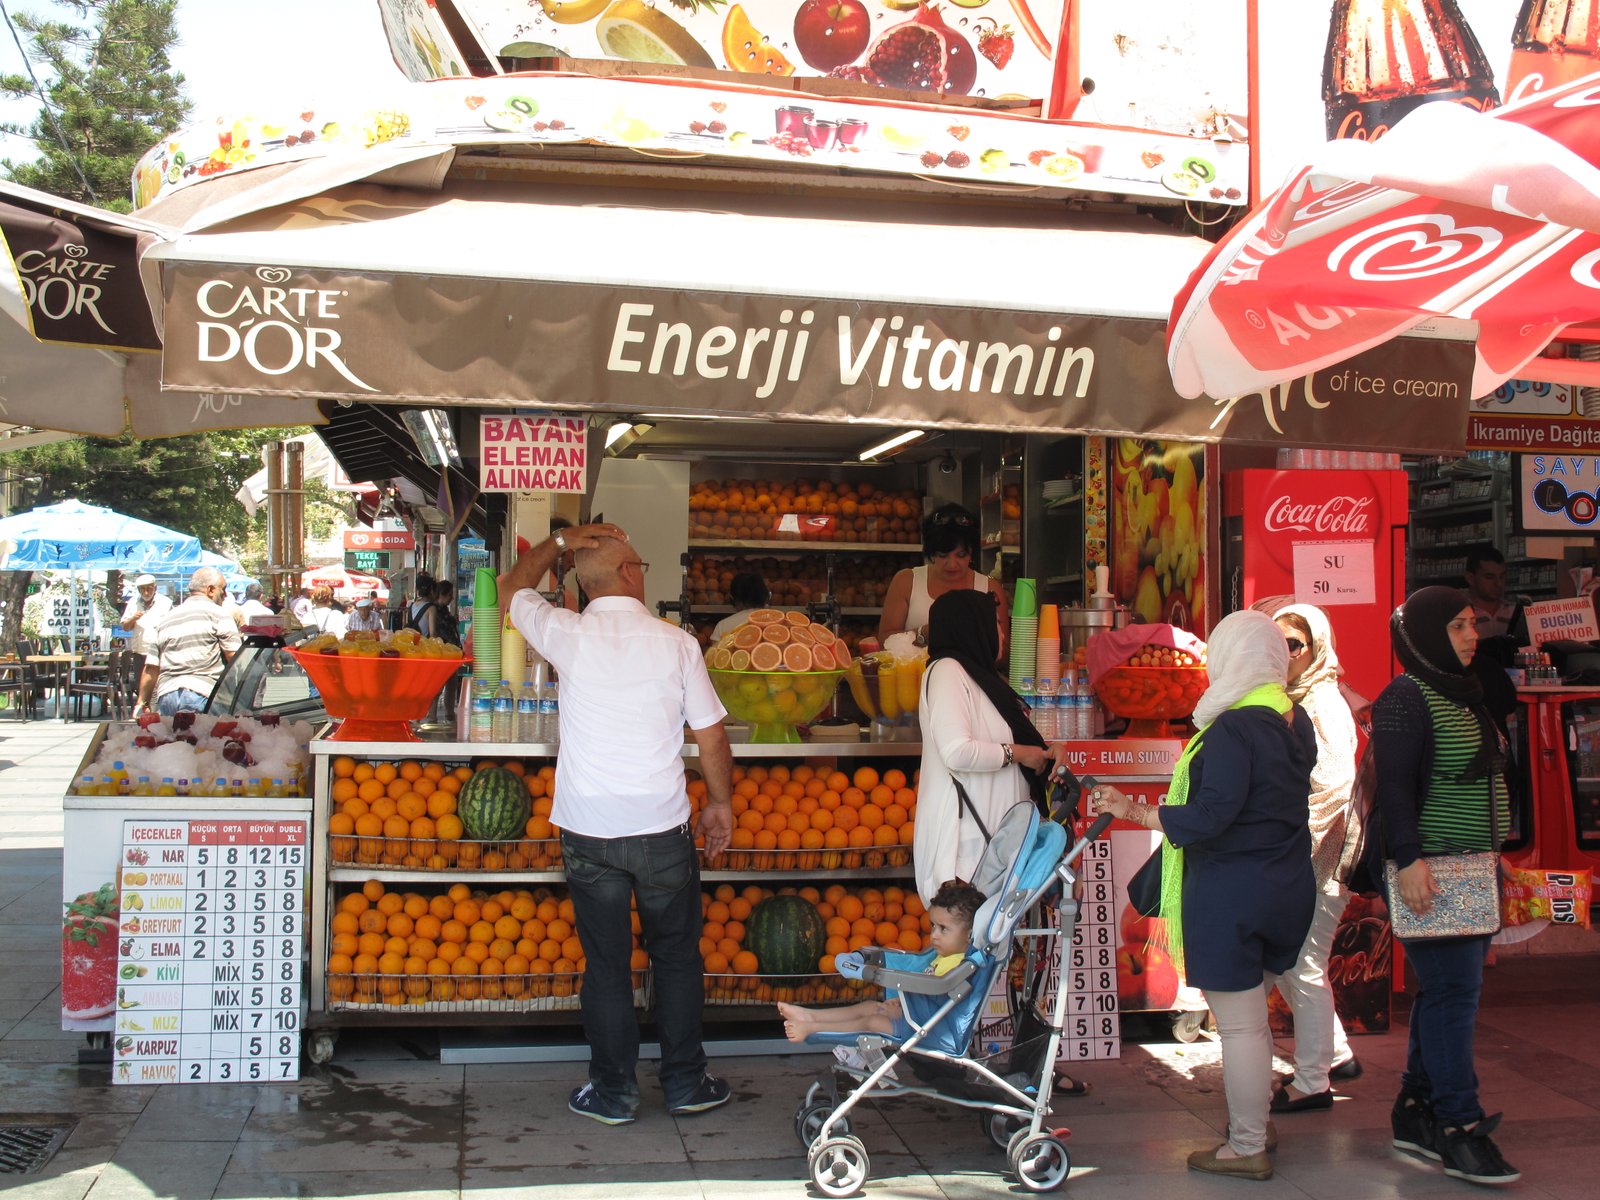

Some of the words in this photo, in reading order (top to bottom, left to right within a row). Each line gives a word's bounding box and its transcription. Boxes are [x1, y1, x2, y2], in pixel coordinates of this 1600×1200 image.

[15, 250, 116, 281] CARTE
[197, 279, 342, 324] CARTE
[606, 302, 816, 399] Enerji
[837, 315, 1096, 398] Vitamin
[1329, 371, 1350, 392] of
[1353, 371, 1386, 394] ice
[1392, 377, 1459, 399] cream
[484, 417, 584, 443] BAYAN
[1473, 419, 1545, 446] İkramiye
[484, 446, 585, 468] ELEMAN
[484, 468, 582, 490] ALINACAK
[1264, 495, 1375, 533] Coca-Cola
[354, 552, 379, 560] TEKEL
[357, 560, 376, 568] BAYİ
[1323, 555, 1345, 569] SU
[1313, 580, 1330, 594] 50
[53, 599, 90, 607] KAIM
[47, 618, 94, 627] CADES
[1541, 612, 1583, 629] BUGÜN
[1534, 626, 1594, 644] ÇEKİLİYOR
[1101, 752, 1134, 764] ELMA
[1137, 752, 1170, 764] SUYU
[131, 826, 182, 842] İÇECEKLER
[192, 825, 217, 834] KÜÇÜK
[250, 825, 274, 833] BÜYÜK
[287, 834, 296, 842] XL
[162, 849, 185, 863] NAR
[197, 848, 209, 865] 5
[226, 847, 238, 865] 8
[249, 847, 271, 864] 12
[279, 847, 301, 864] 15
[1089, 842, 1109, 858] 15
[150, 873, 184, 886] PORTAKAL
[197, 869, 206, 888] 1
[224, 870, 237, 888] 2
[254, 869, 267, 888] 3
[283, 869, 296, 888] 5
[1095, 862, 1106, 880] 5
[150, 894, 182, 910] LİMON
[194, 893, 207, 911] 2
[223, 893, 236, 911] 3
[254, 893, 266, 911] 5
[283, 892, 295, 911] 8
[1096, 884, 1106, 901] 8
[1097, 905, 1108, 922] 8
[142, 919, 182, 934] GREYFURT
[193, 915, 207, 934] 2
[223, 915, 235, 934] 3
[253, 915, 266, 934] 5
[282, 915, 294, 934] 8
[1072, 928, 1083, 946] 5
[1097, 927, 1109, 945] 8
[151, 942, 181, 957] ELMA
[193, 940, 206, 958] 2
[222, 939, 235, 958] 3
[252, 939, 265, 958] 5
[281, 939, 294, 958] 8
[1073, 949, 1085, 967] 5
[1098, 948, 1110, 966] 8
[156, 963, 180, 981] KİVİ
[215, 961, 241, 982] MİX
[251, 962, 265, 981] 5
[280, 962, 294, 981] 8
[1074, 972, 1085, 990] 5
[1099, 971, 1111, 989] 8
[143, 991, 180, 1006] ANANAS
[214, 986, 240, 1006] MİX
[251, 987, 264, 1006] 5
[280, 986, 293, 1005] 8
[990, 1001, 1008, 1014] MU
[1075, 996, 1086, 1011] 7
[1095, 994, 1116, 1012] 10
[152, 1015, 179, 1030] MUZ
[213, 1010, 239, 1031] MİX
[251, 1013, 263, 1028] 7
[274, 1010, 297, 1030] 10
[1076, 1018, 1088, 1036] 5
[1101, 1017, 1113, 1035] 8
[136, 1040, 178, 1056] KARPUZ
[249, 1036, 263, 1056] 5
[278, 1036, 292, 1055] 8
[1079, 1041, 1089, 1057] 5
[1104, 1041, 1114, 1056] 7
[141, 1065, 177, 1083] HAVUÇ
[190, 1063, 202, 1080] 2
[220, 1062, 231, 1079] 3
[249, 1062, 261, 1079] 5
[280, 1061, 291, 1078] 7
